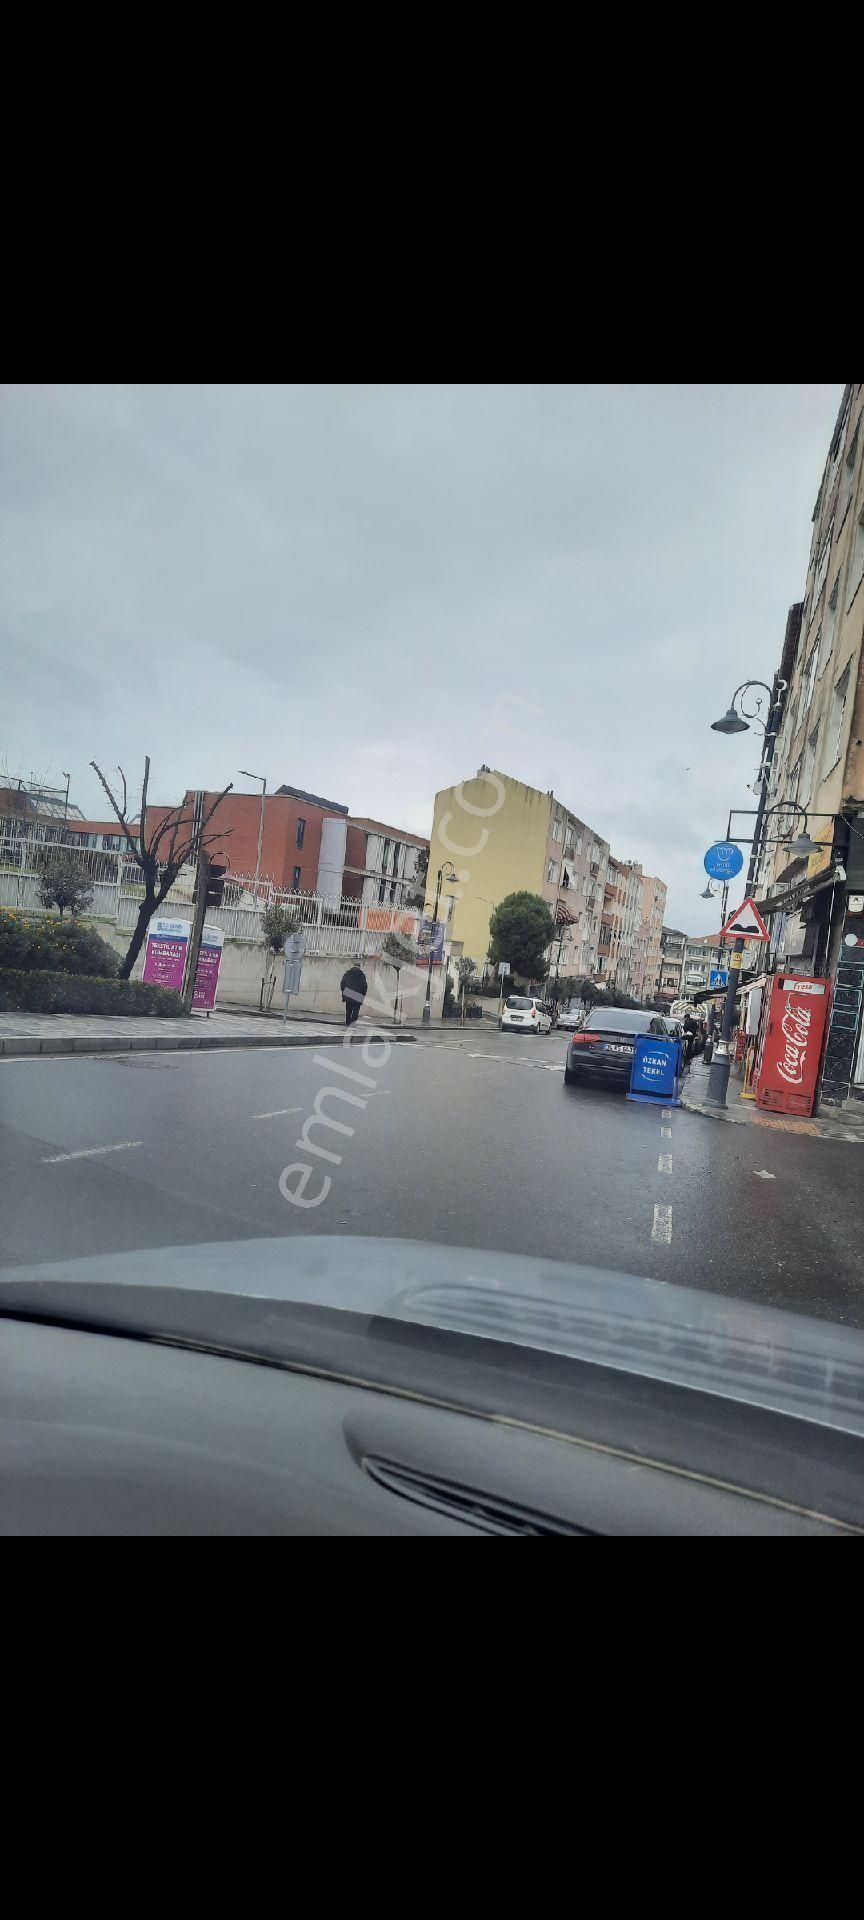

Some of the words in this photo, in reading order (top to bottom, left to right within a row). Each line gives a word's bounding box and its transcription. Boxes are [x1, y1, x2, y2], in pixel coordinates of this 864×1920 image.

[777, 1000, 812, 1084] Coca-Cola
[642, 1055, 667, 1067] ÖZKAN
[642, 1066, 665, 1076] TEKEL
